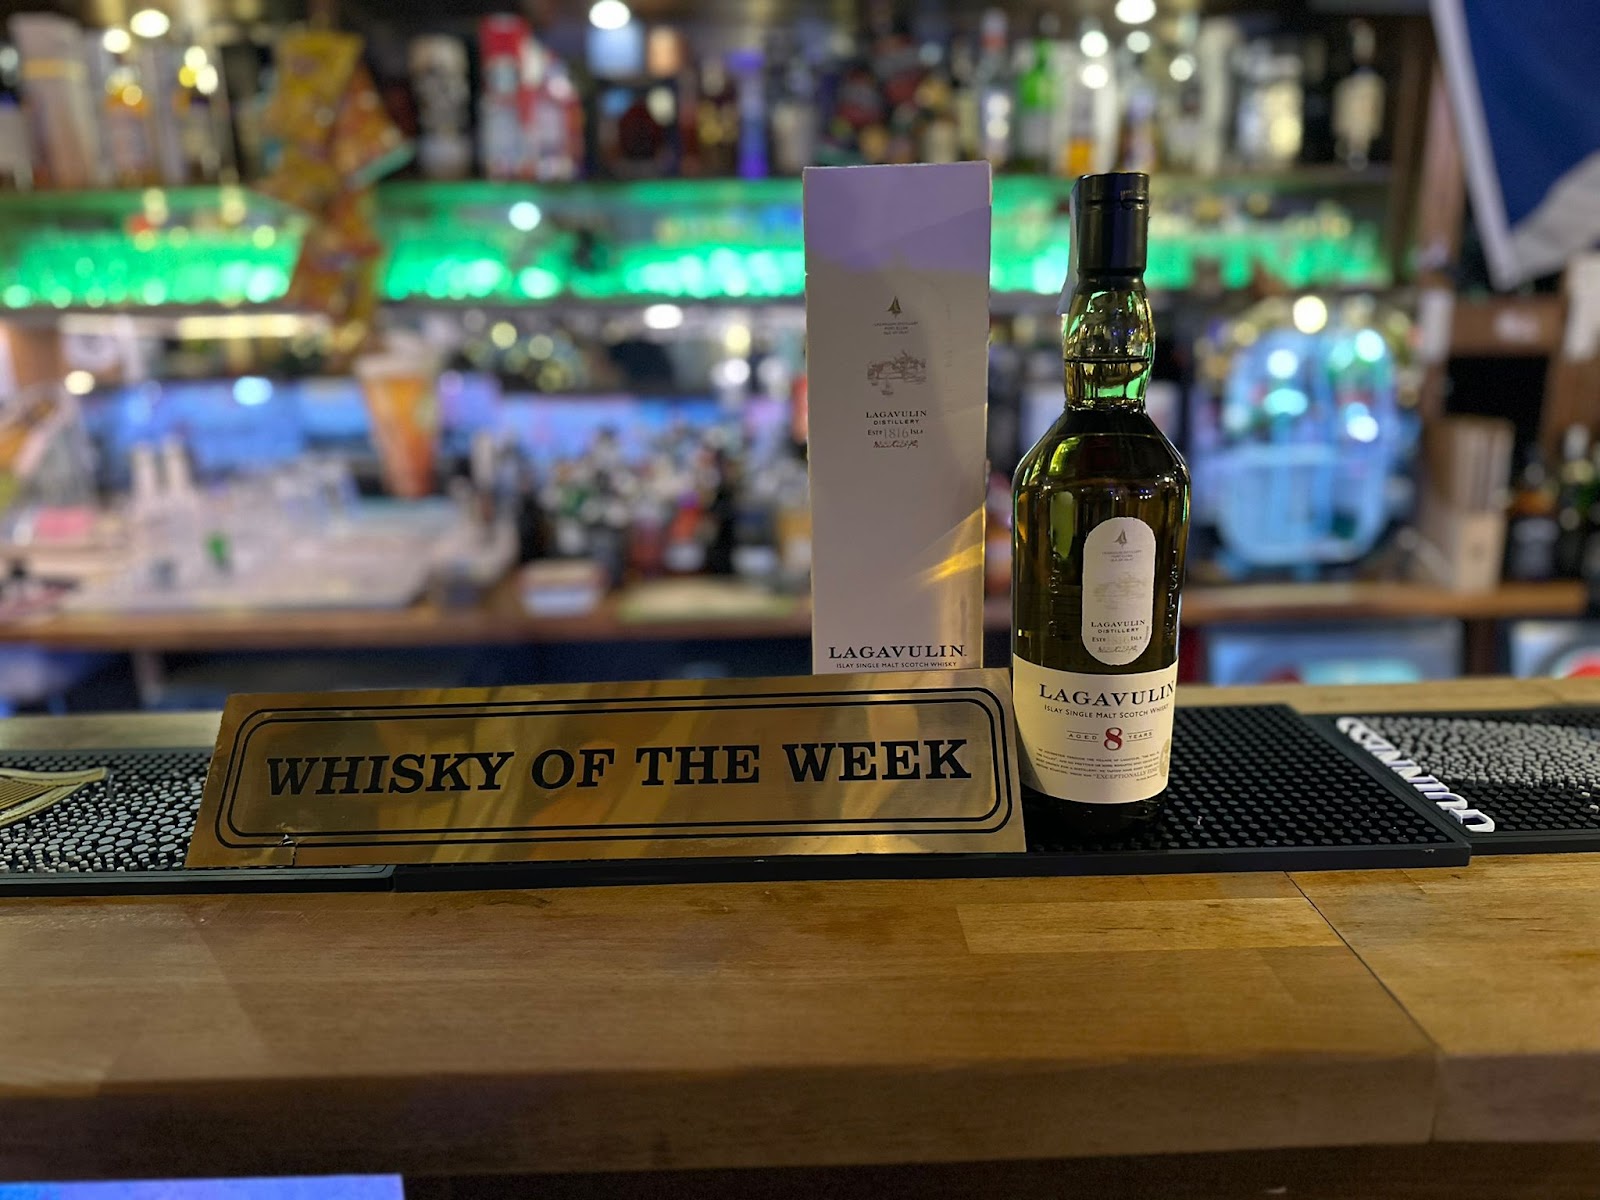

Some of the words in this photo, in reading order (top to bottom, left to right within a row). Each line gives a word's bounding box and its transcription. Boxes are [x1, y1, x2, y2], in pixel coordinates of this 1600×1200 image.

[866, 410, 927, 418] LAGAVULIN
[1091, 620, 1145, 628] LAGAVULIN
[828, 644, 966, 659] LAGAVULIN
[1039, 680, 1174, 707] LAGAVULIN
[1044, 704, 1063, 714] ISLAY
[1065, 708, 1093, 719] SINGLE
[1119, 711, 1148, 719] SCOTCH
[1149, 703, 1169, 714] WHISKY
[1103, 726, 1123, 751] 8
[1128, 731, 1153, 739] YEARS
[266, 751, 515, 796] WHISKY
[531, 748, 615, 790] OF
[635, 745, 760, 786] THE
[782, 739, 972, 783] WEEK
